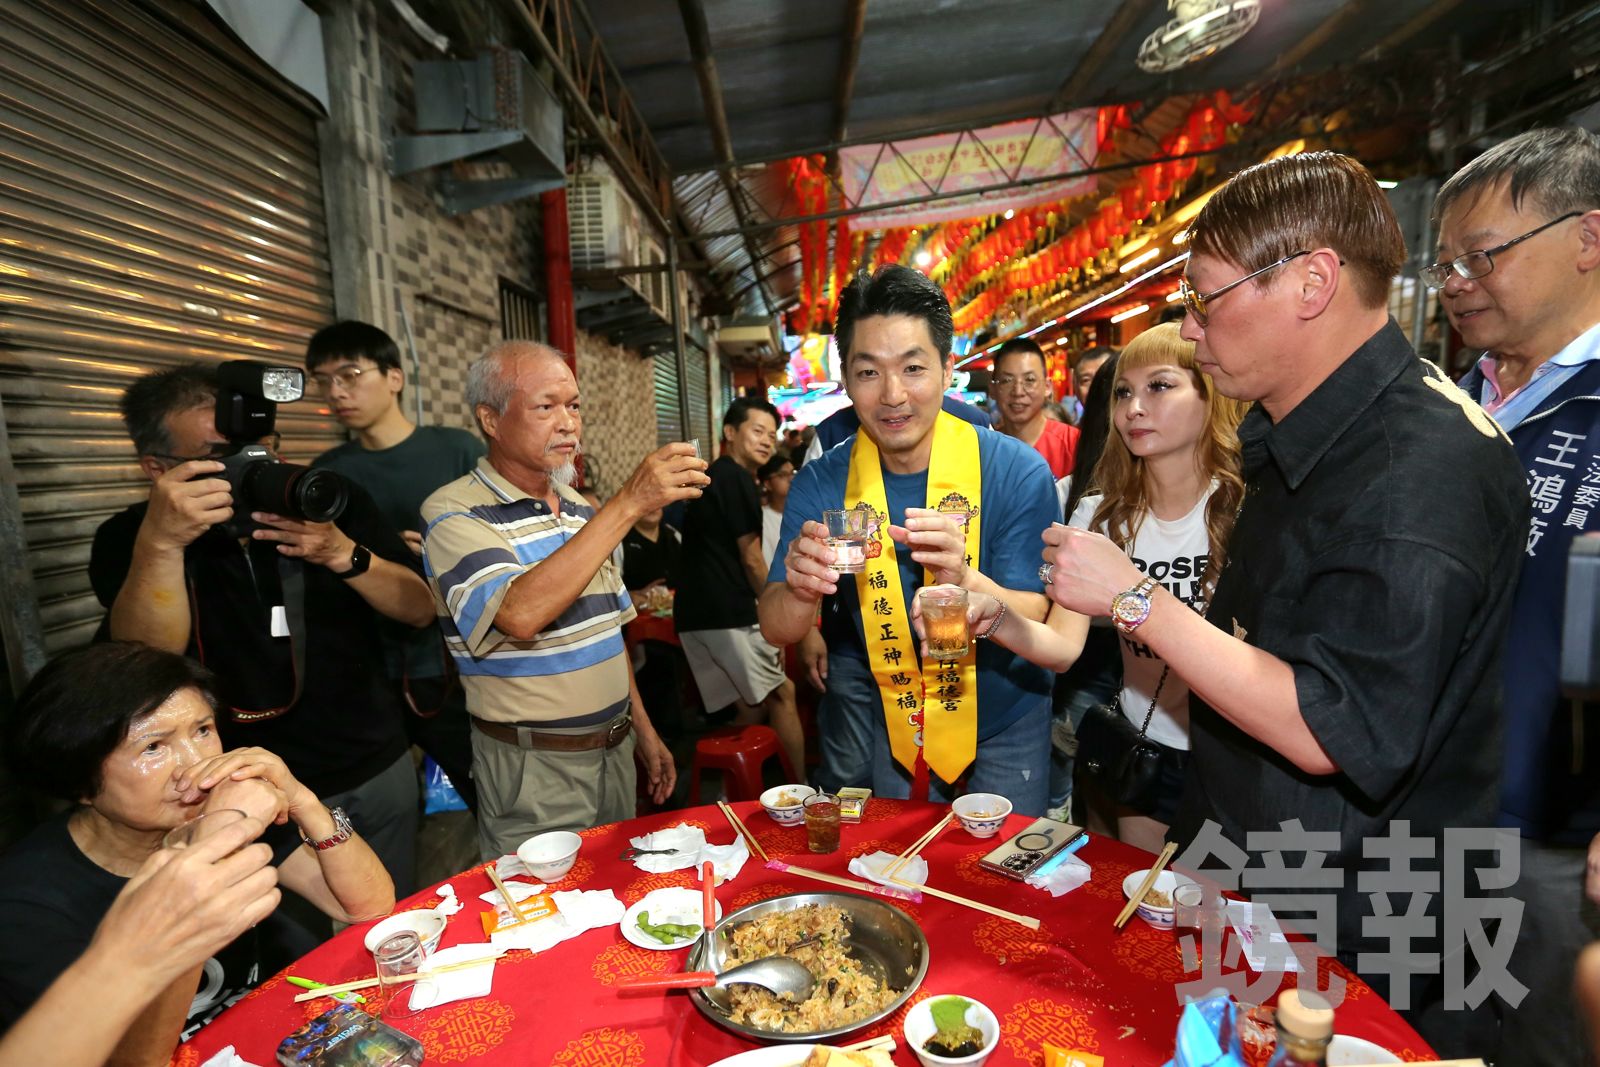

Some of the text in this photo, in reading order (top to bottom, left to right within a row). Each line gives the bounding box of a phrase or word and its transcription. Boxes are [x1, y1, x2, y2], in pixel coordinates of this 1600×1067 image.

[1562, 454, 1600, 530] 法委員
[868, 570, 918, 710] 福德正神賜福
